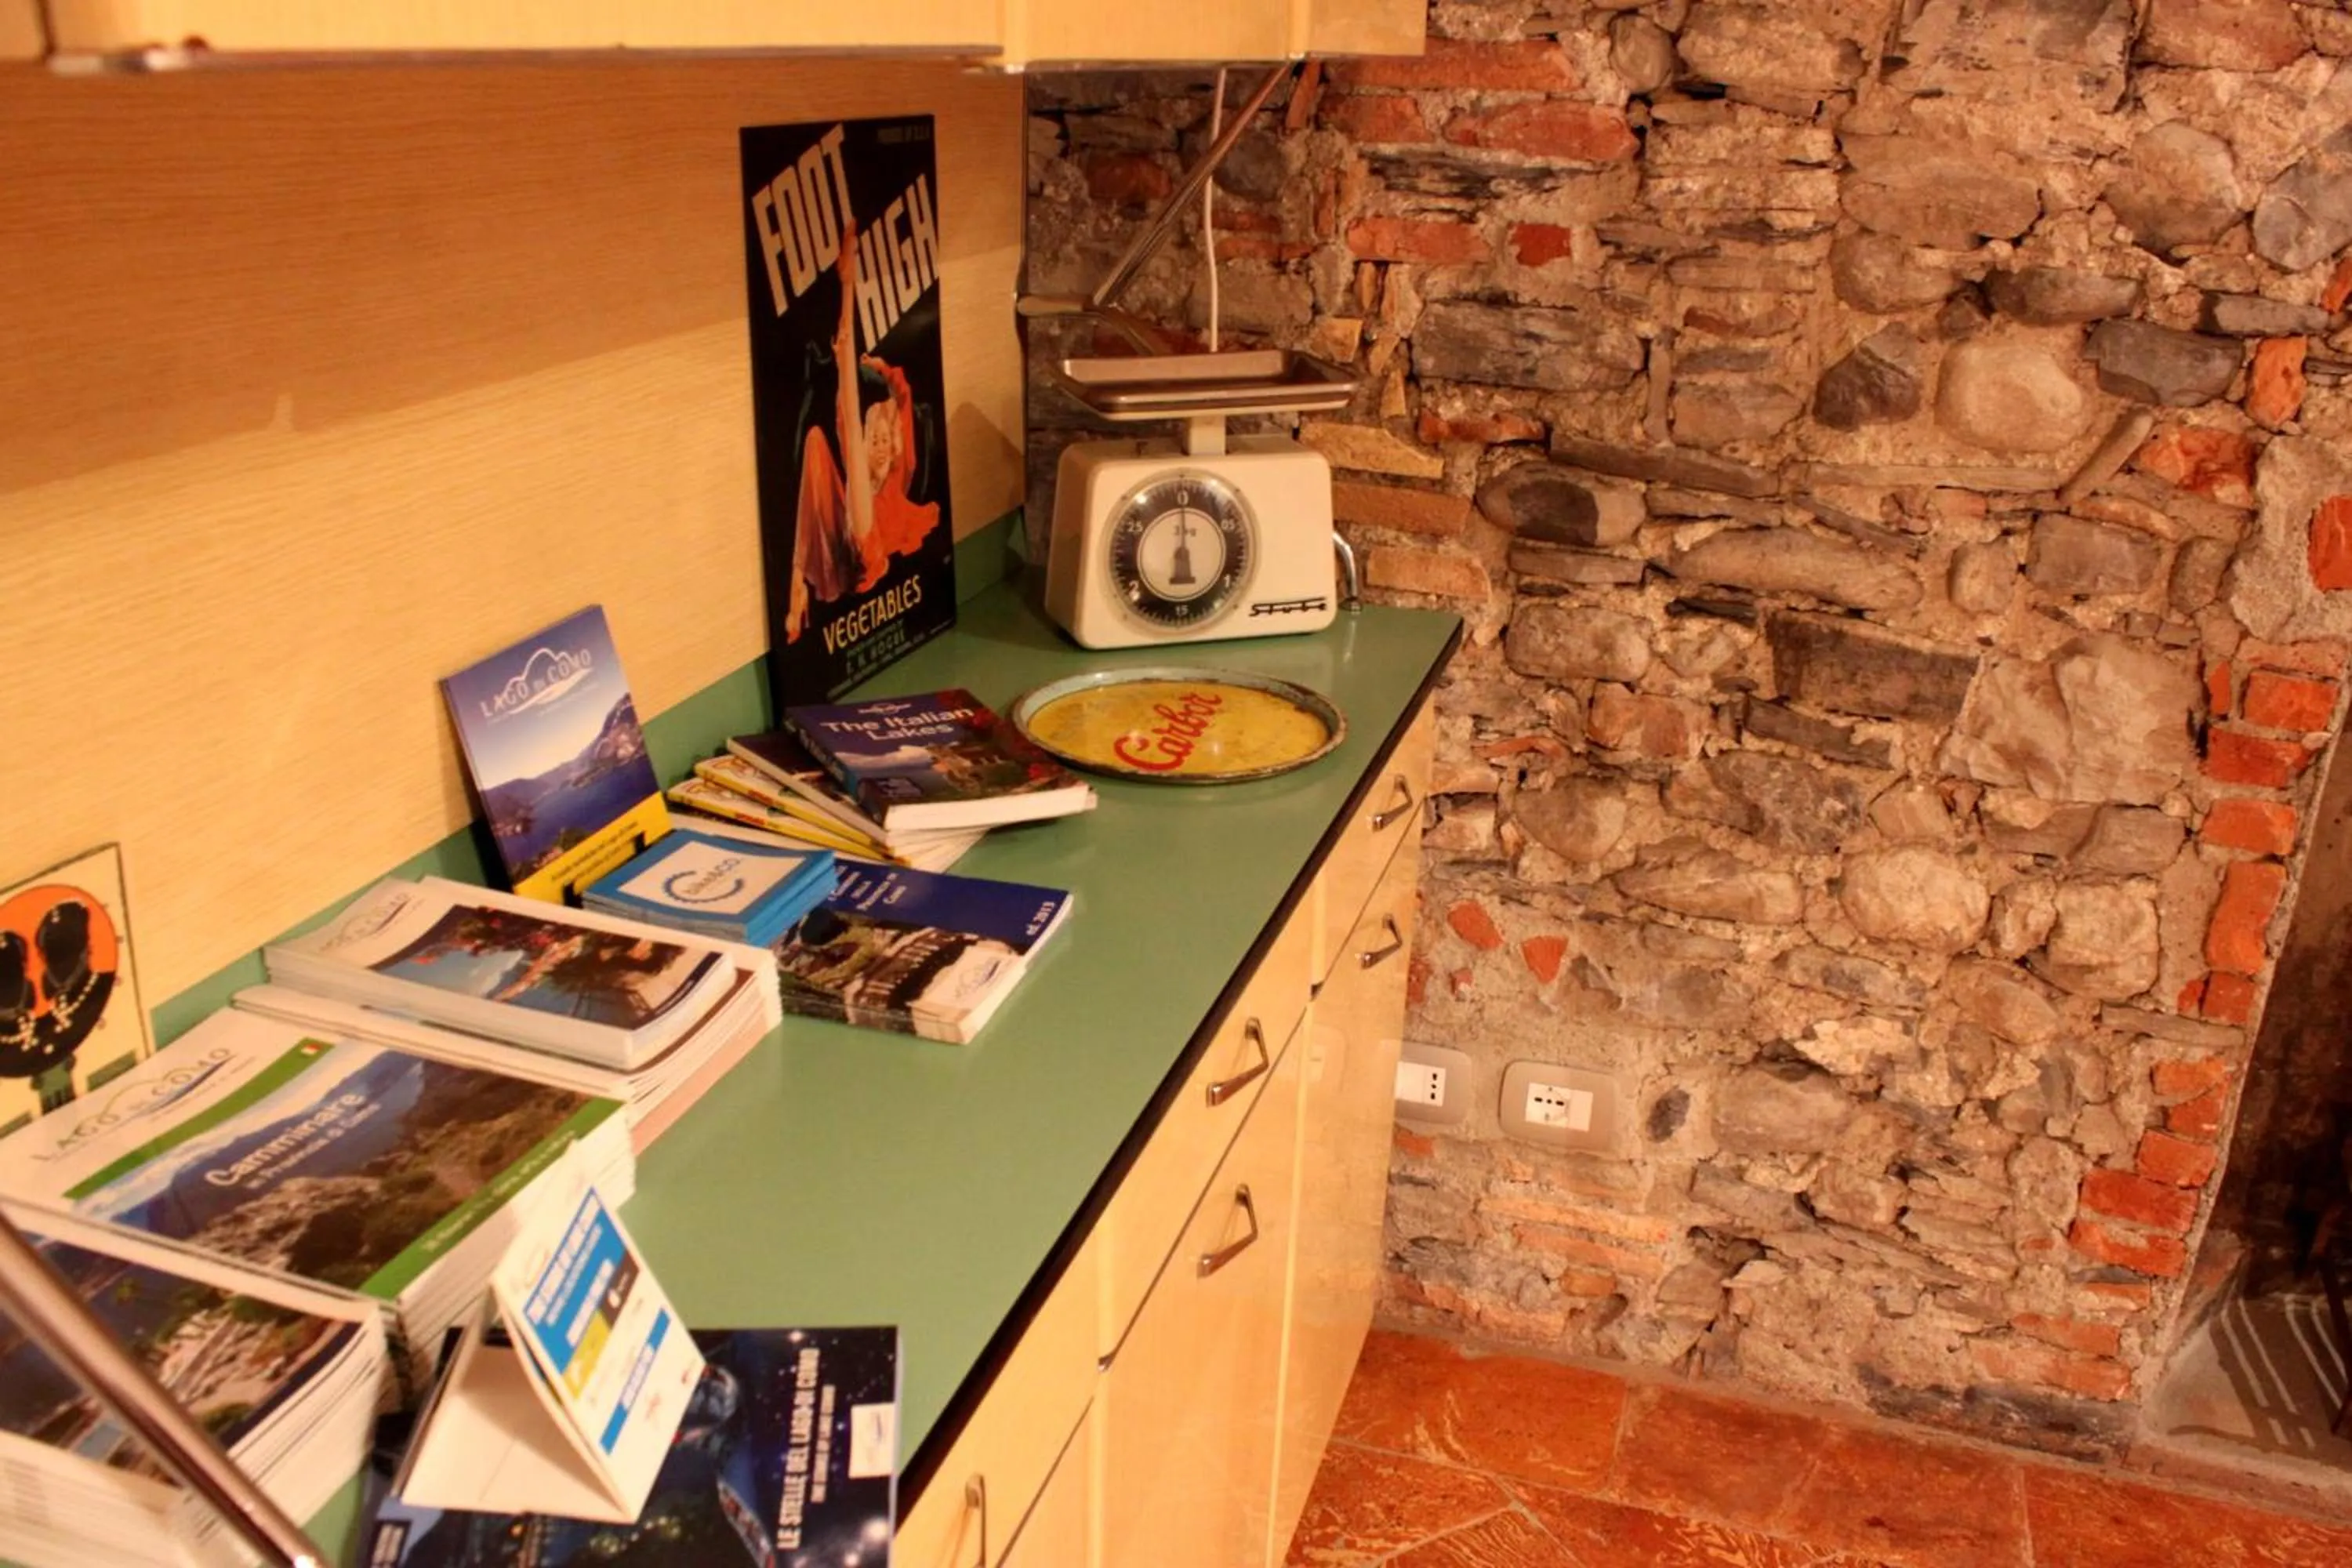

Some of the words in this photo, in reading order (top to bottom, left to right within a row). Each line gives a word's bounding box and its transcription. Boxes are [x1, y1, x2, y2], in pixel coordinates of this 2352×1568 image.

[752, 122, 856, 318] FOOT
[855, 172, 939, 353] HIGH
[822, 574, 923, 655] VEGETABLES
[480, 681, 529, 717] LAGO
[819, 721, 880, 733] The
[884, 708, 975, 728] Italian
[866, 724, 955, 741] Lakes
[204, 1094, 368, 1186] Camminare
[777, 1528, 800, 1550] LE
